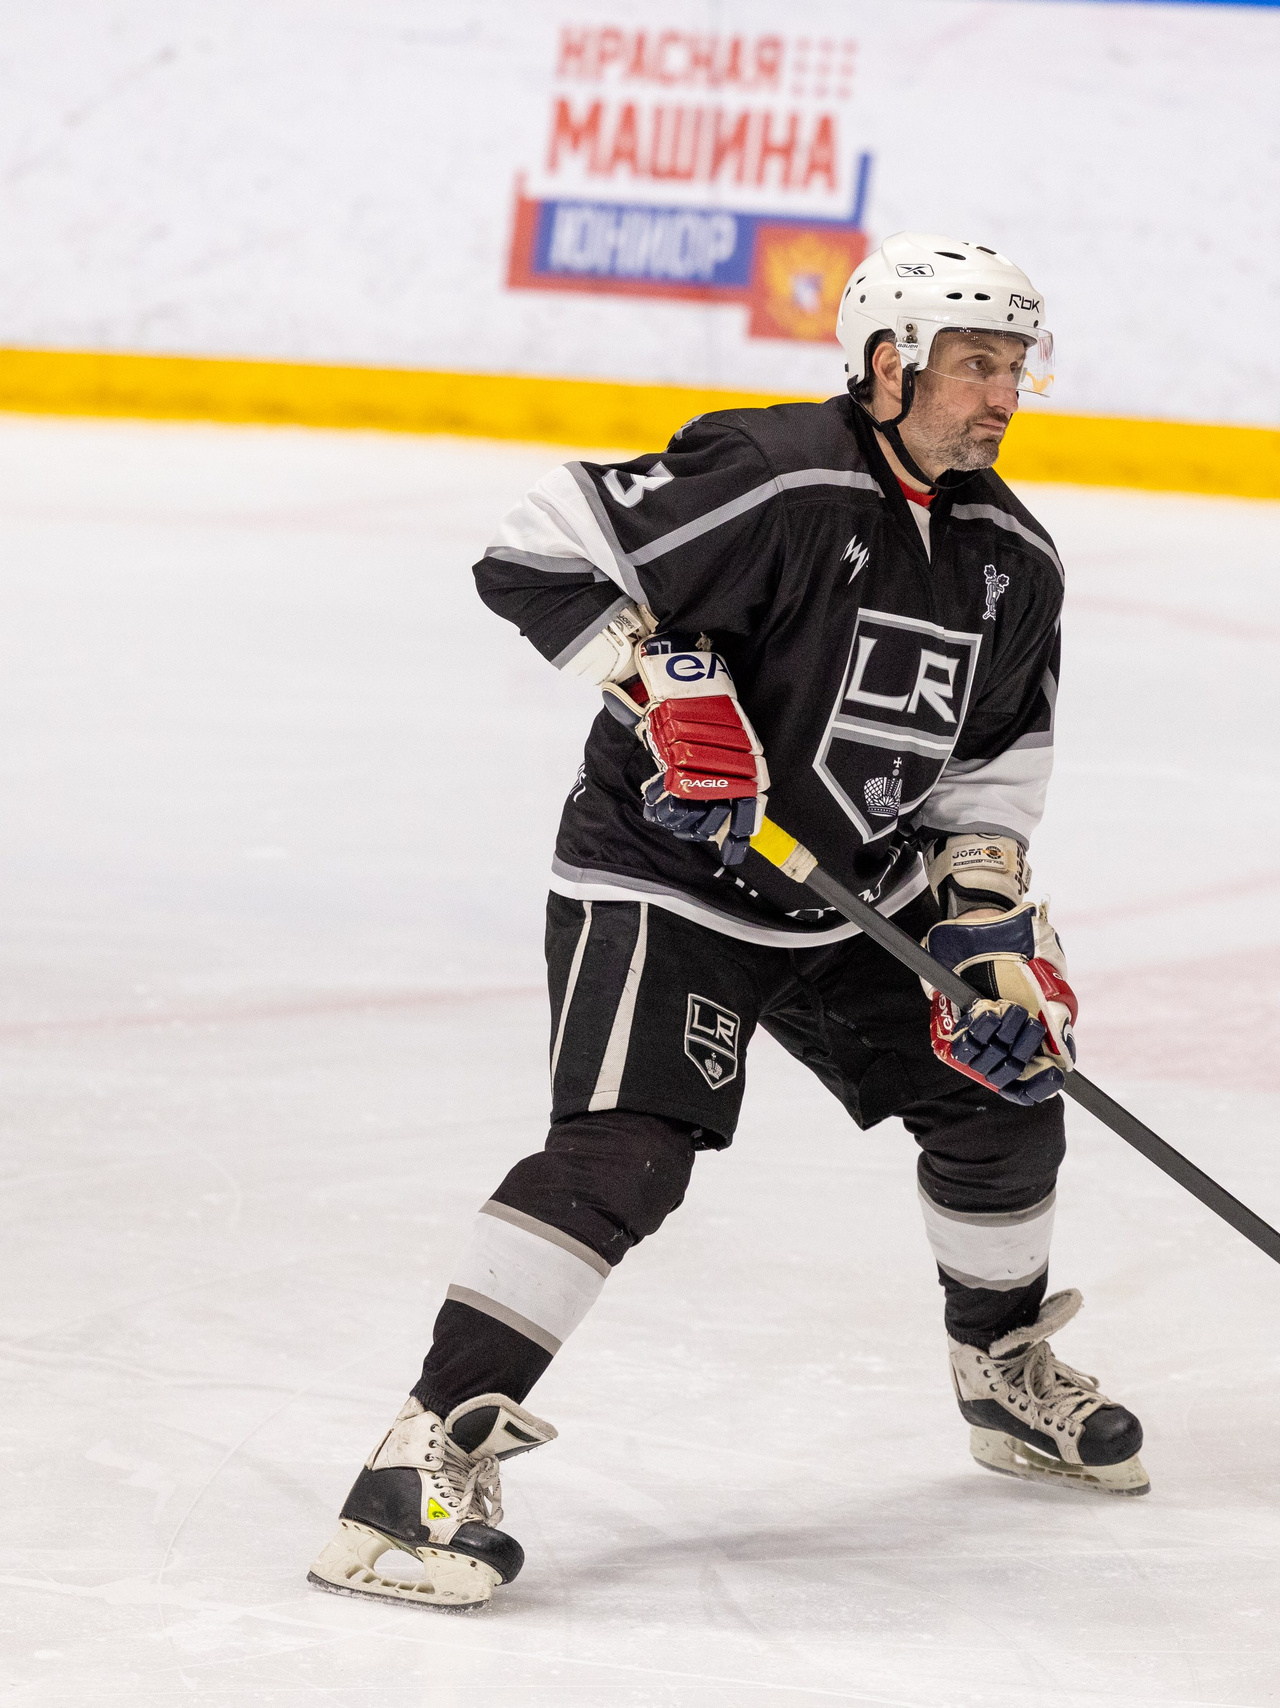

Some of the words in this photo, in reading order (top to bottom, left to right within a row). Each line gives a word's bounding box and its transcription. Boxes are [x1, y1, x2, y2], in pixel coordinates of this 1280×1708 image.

[557, 25, 785, 92] КРАСНАЯ
[545, 98, 838, 195] МАШИНА
[550, 207, 738, 280] ЮНИОР
[844, 635, 961, 725] LR
[952, 847, 984, 859] JOFA
[691, 1002, 737, 1048] LR
